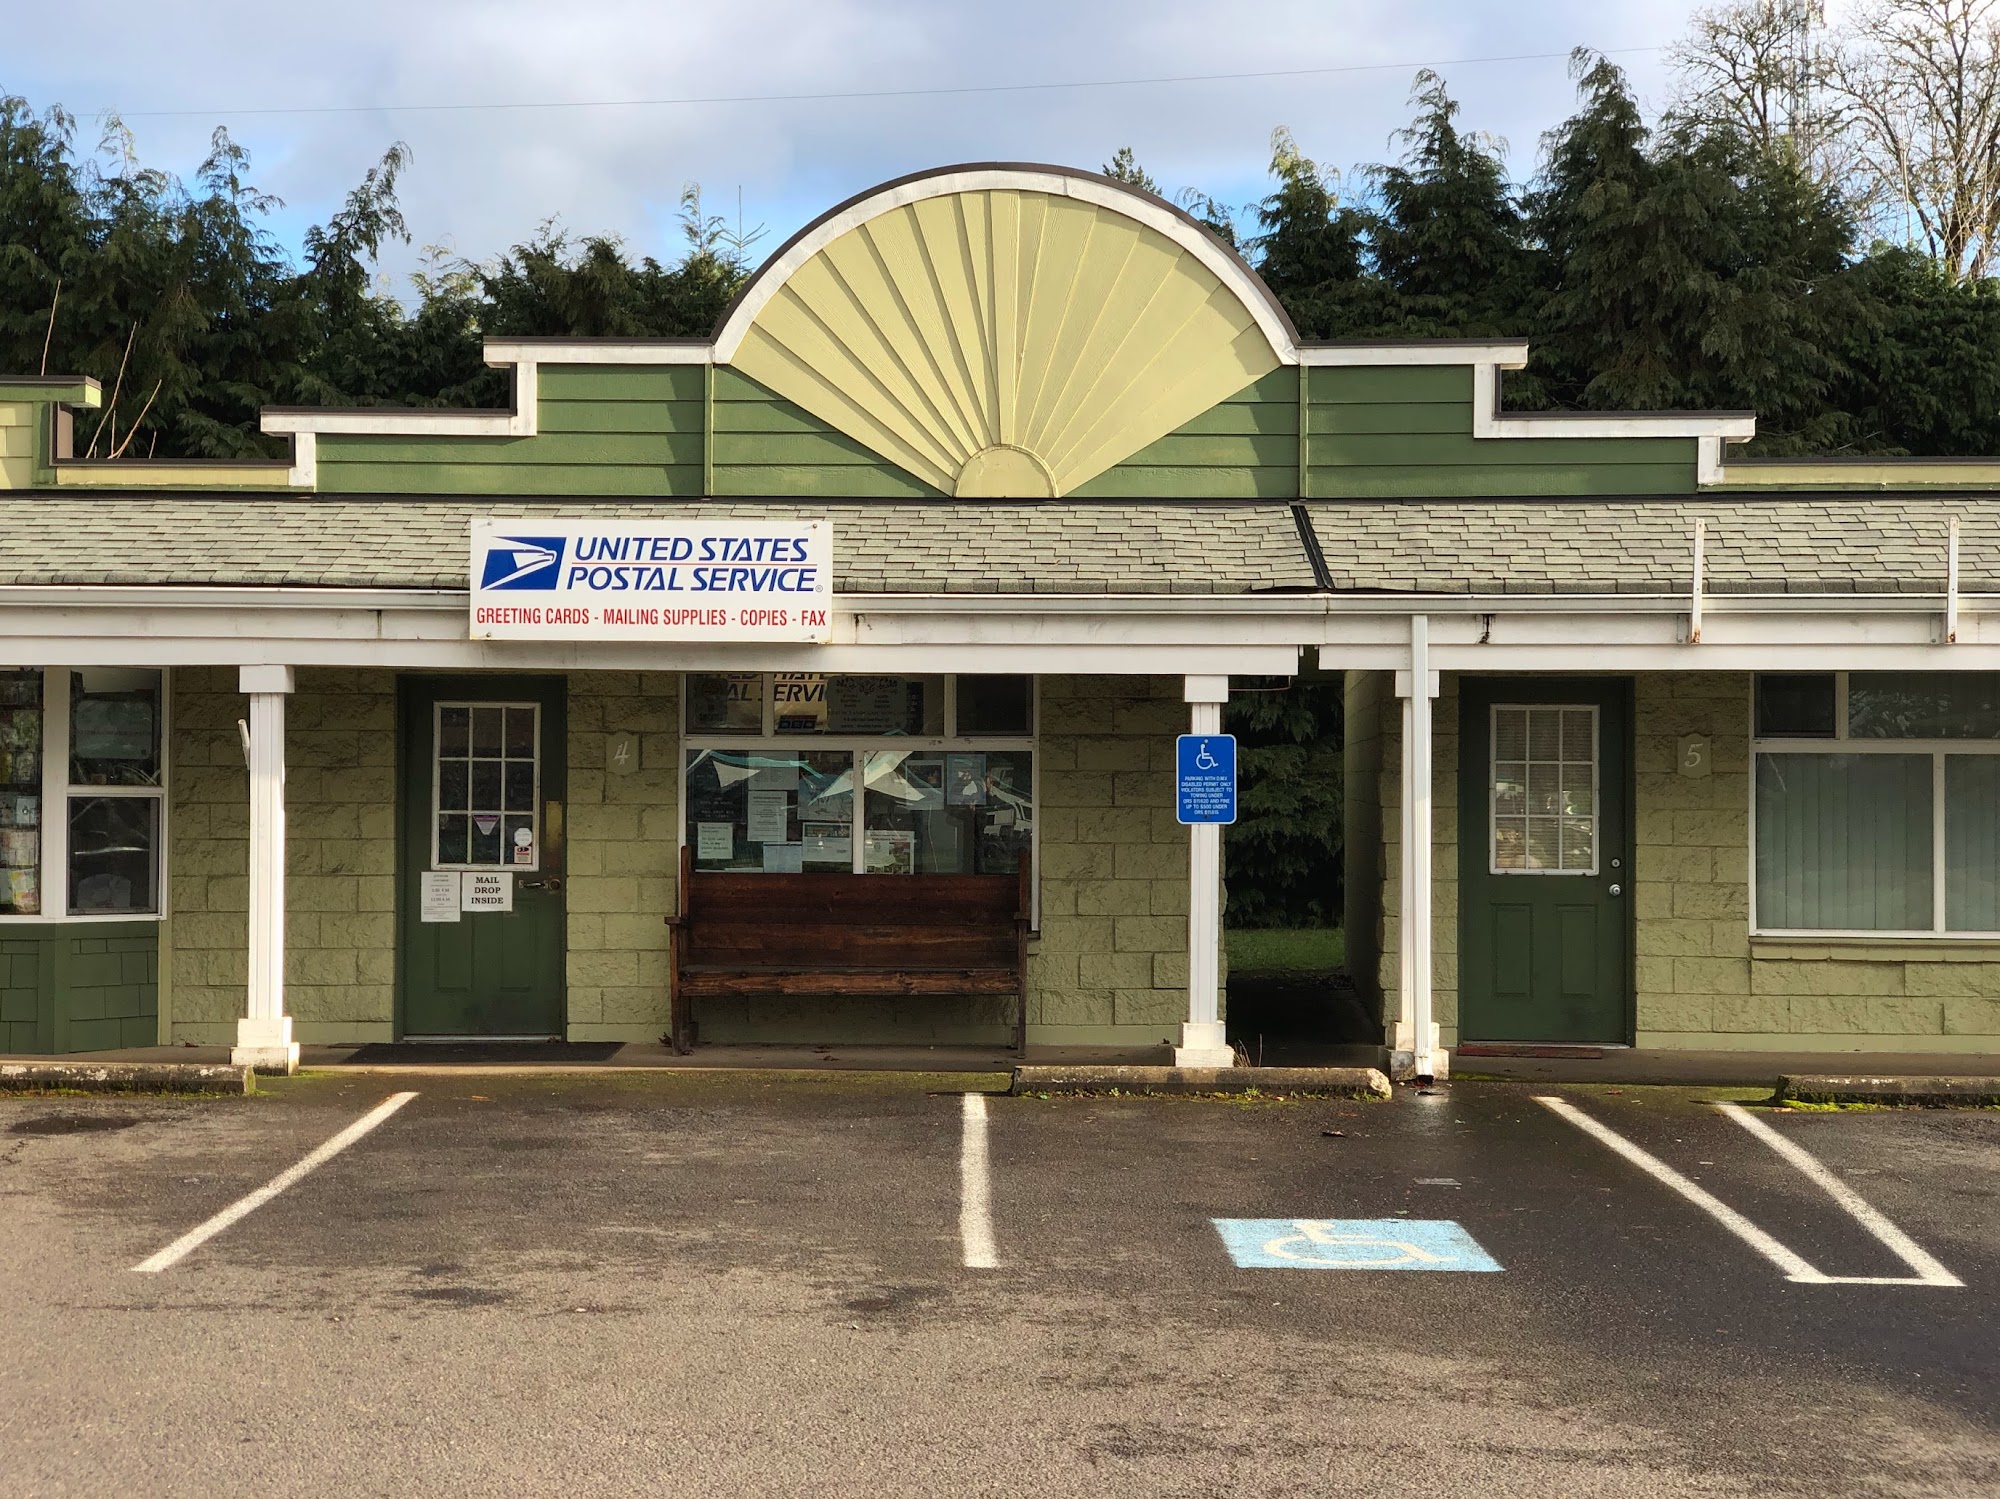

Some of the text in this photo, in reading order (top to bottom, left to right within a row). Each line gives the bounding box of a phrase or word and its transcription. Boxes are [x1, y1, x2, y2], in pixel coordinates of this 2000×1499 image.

[575, 536, 809, 562] UNITED STATES
[566, 566, 684, 591] POSTAL
[476, 607, 541, 625] GREETING
[545, 608, 589, 625] CARDS
[603, 608, 659, 625] MAILING
[663, 609, 727, 626] SUPPLIES
[740, 609, 787, 626] COPIES
[801, 610, 827, 626] FAX
[613, 740, 631, 765] 4
[1684, 743, 1704, 767] 5
